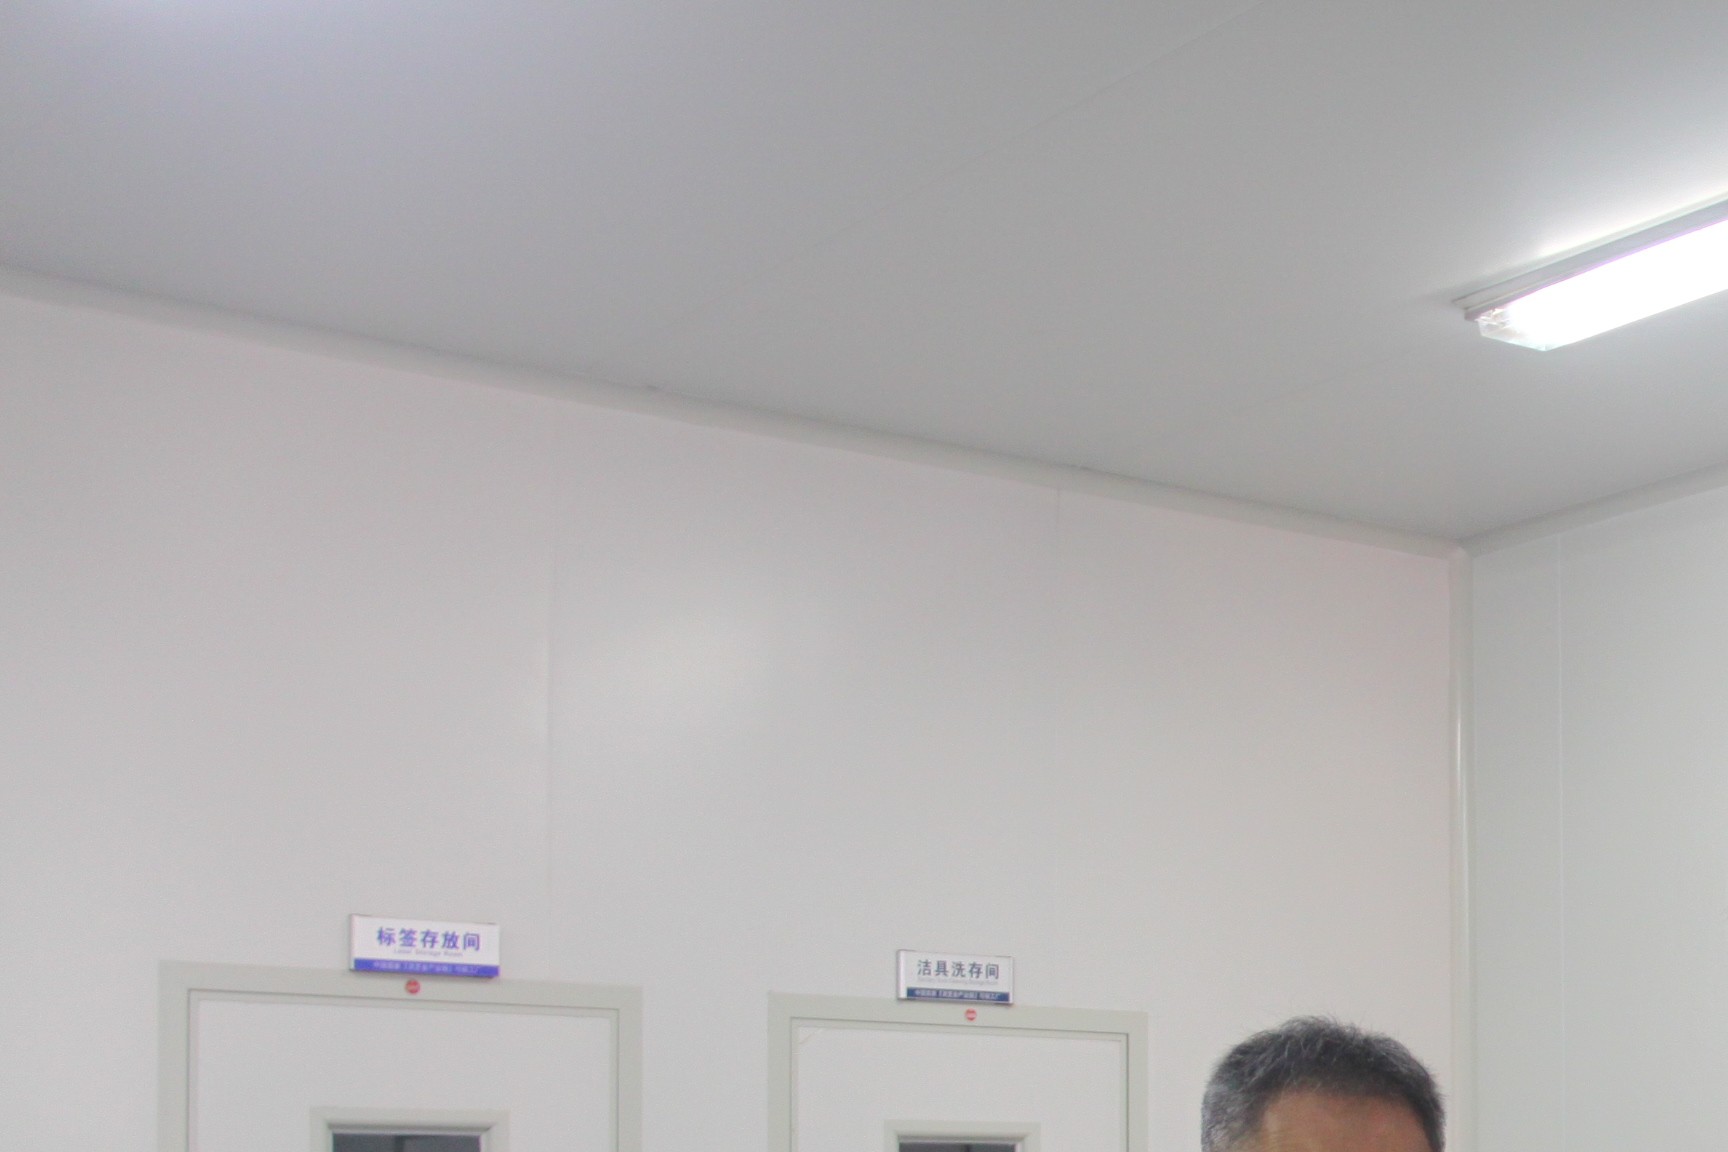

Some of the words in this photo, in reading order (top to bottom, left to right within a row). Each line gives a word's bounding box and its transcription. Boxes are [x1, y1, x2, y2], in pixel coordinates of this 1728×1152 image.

[376, 926, 481, 952] 标签存放间
[917, 959, 999, 980] 洁具洗存间
